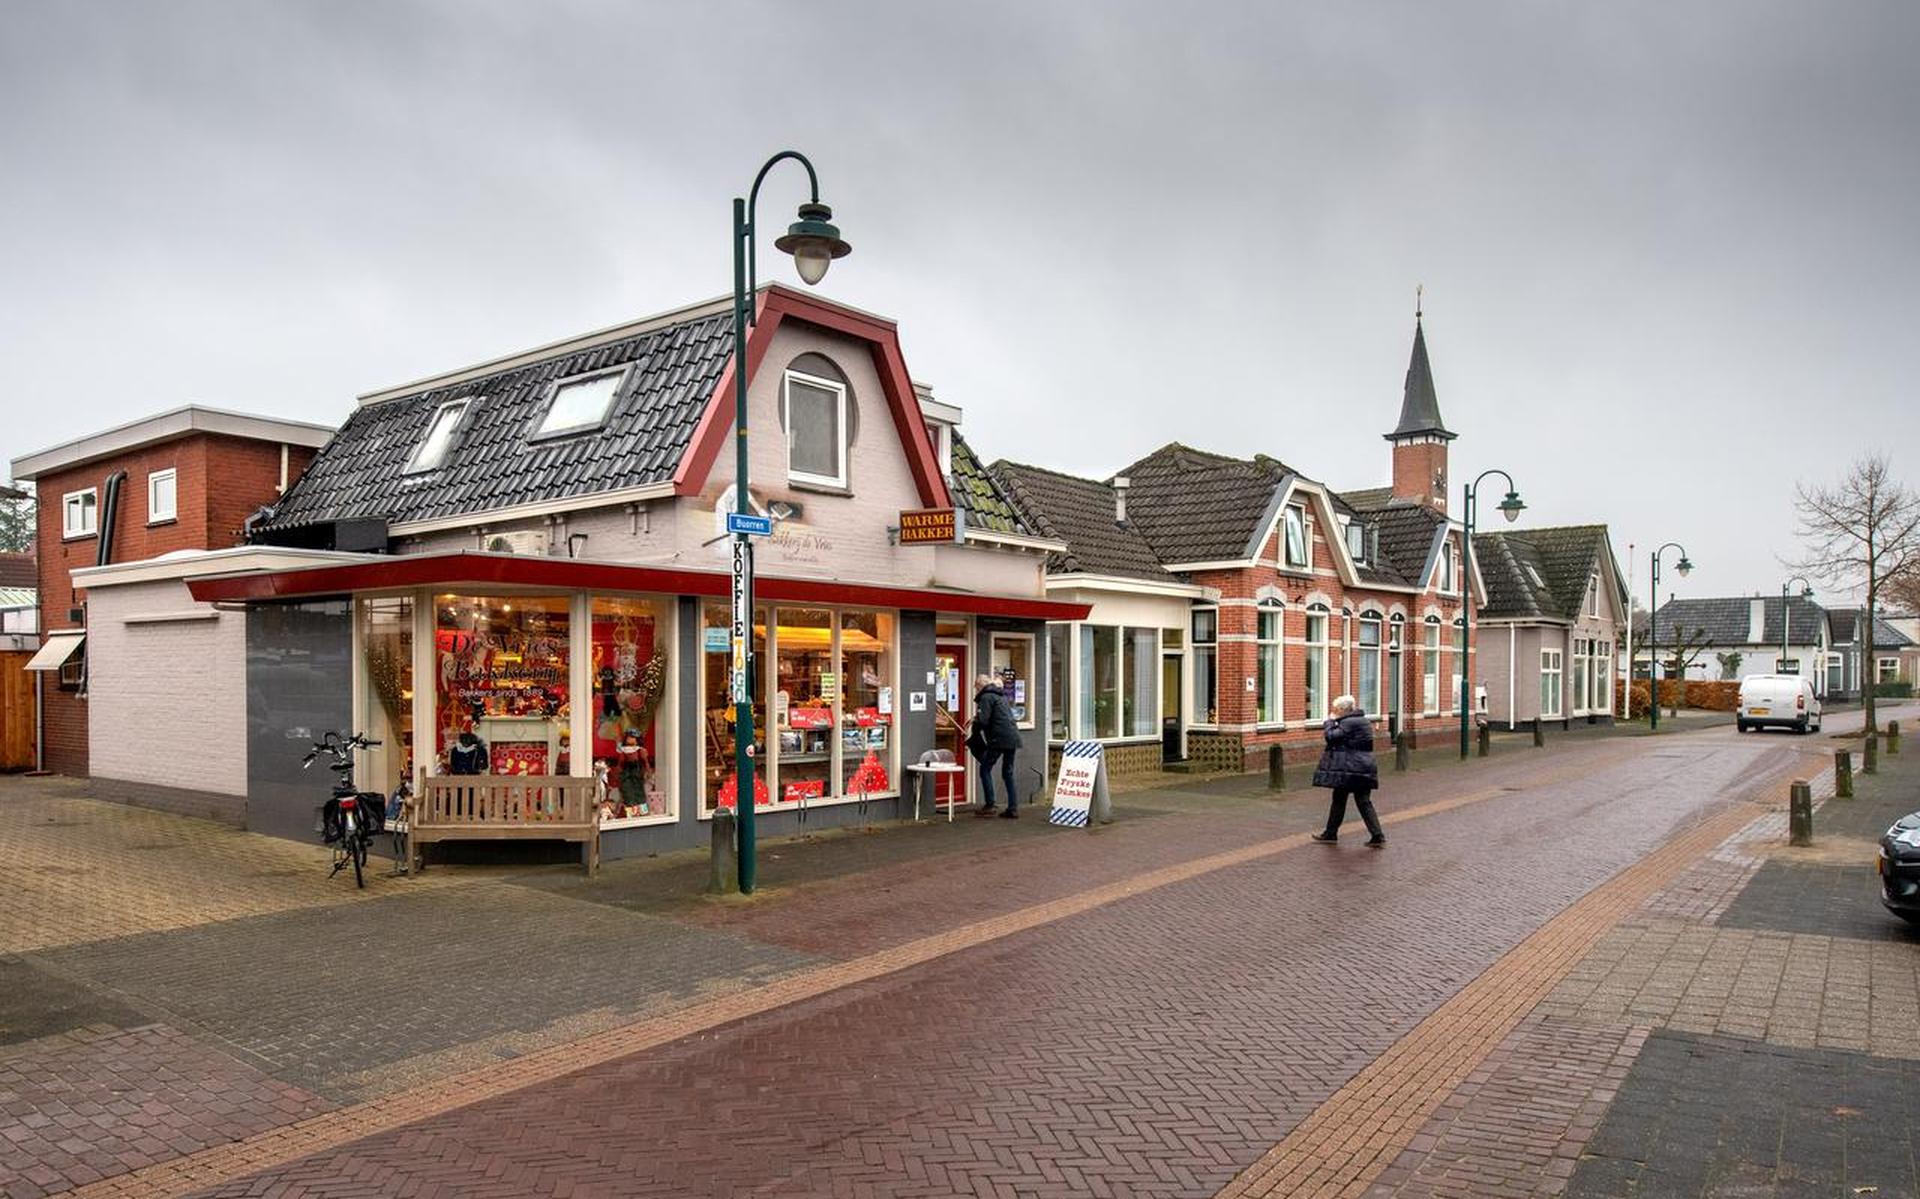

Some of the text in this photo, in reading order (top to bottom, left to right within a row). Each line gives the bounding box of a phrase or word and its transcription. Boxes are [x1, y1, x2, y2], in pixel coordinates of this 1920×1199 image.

[736, 518, 765, 531] Buorren
[902, 513, 954, 527] WARME
[902, 527, 954, 540] BAKKER
[733, 542, 744, 702] KOFFIE TO GO
[484, 634, 558, 655] Vries
[1066, 769, 1089, 778] Echte
